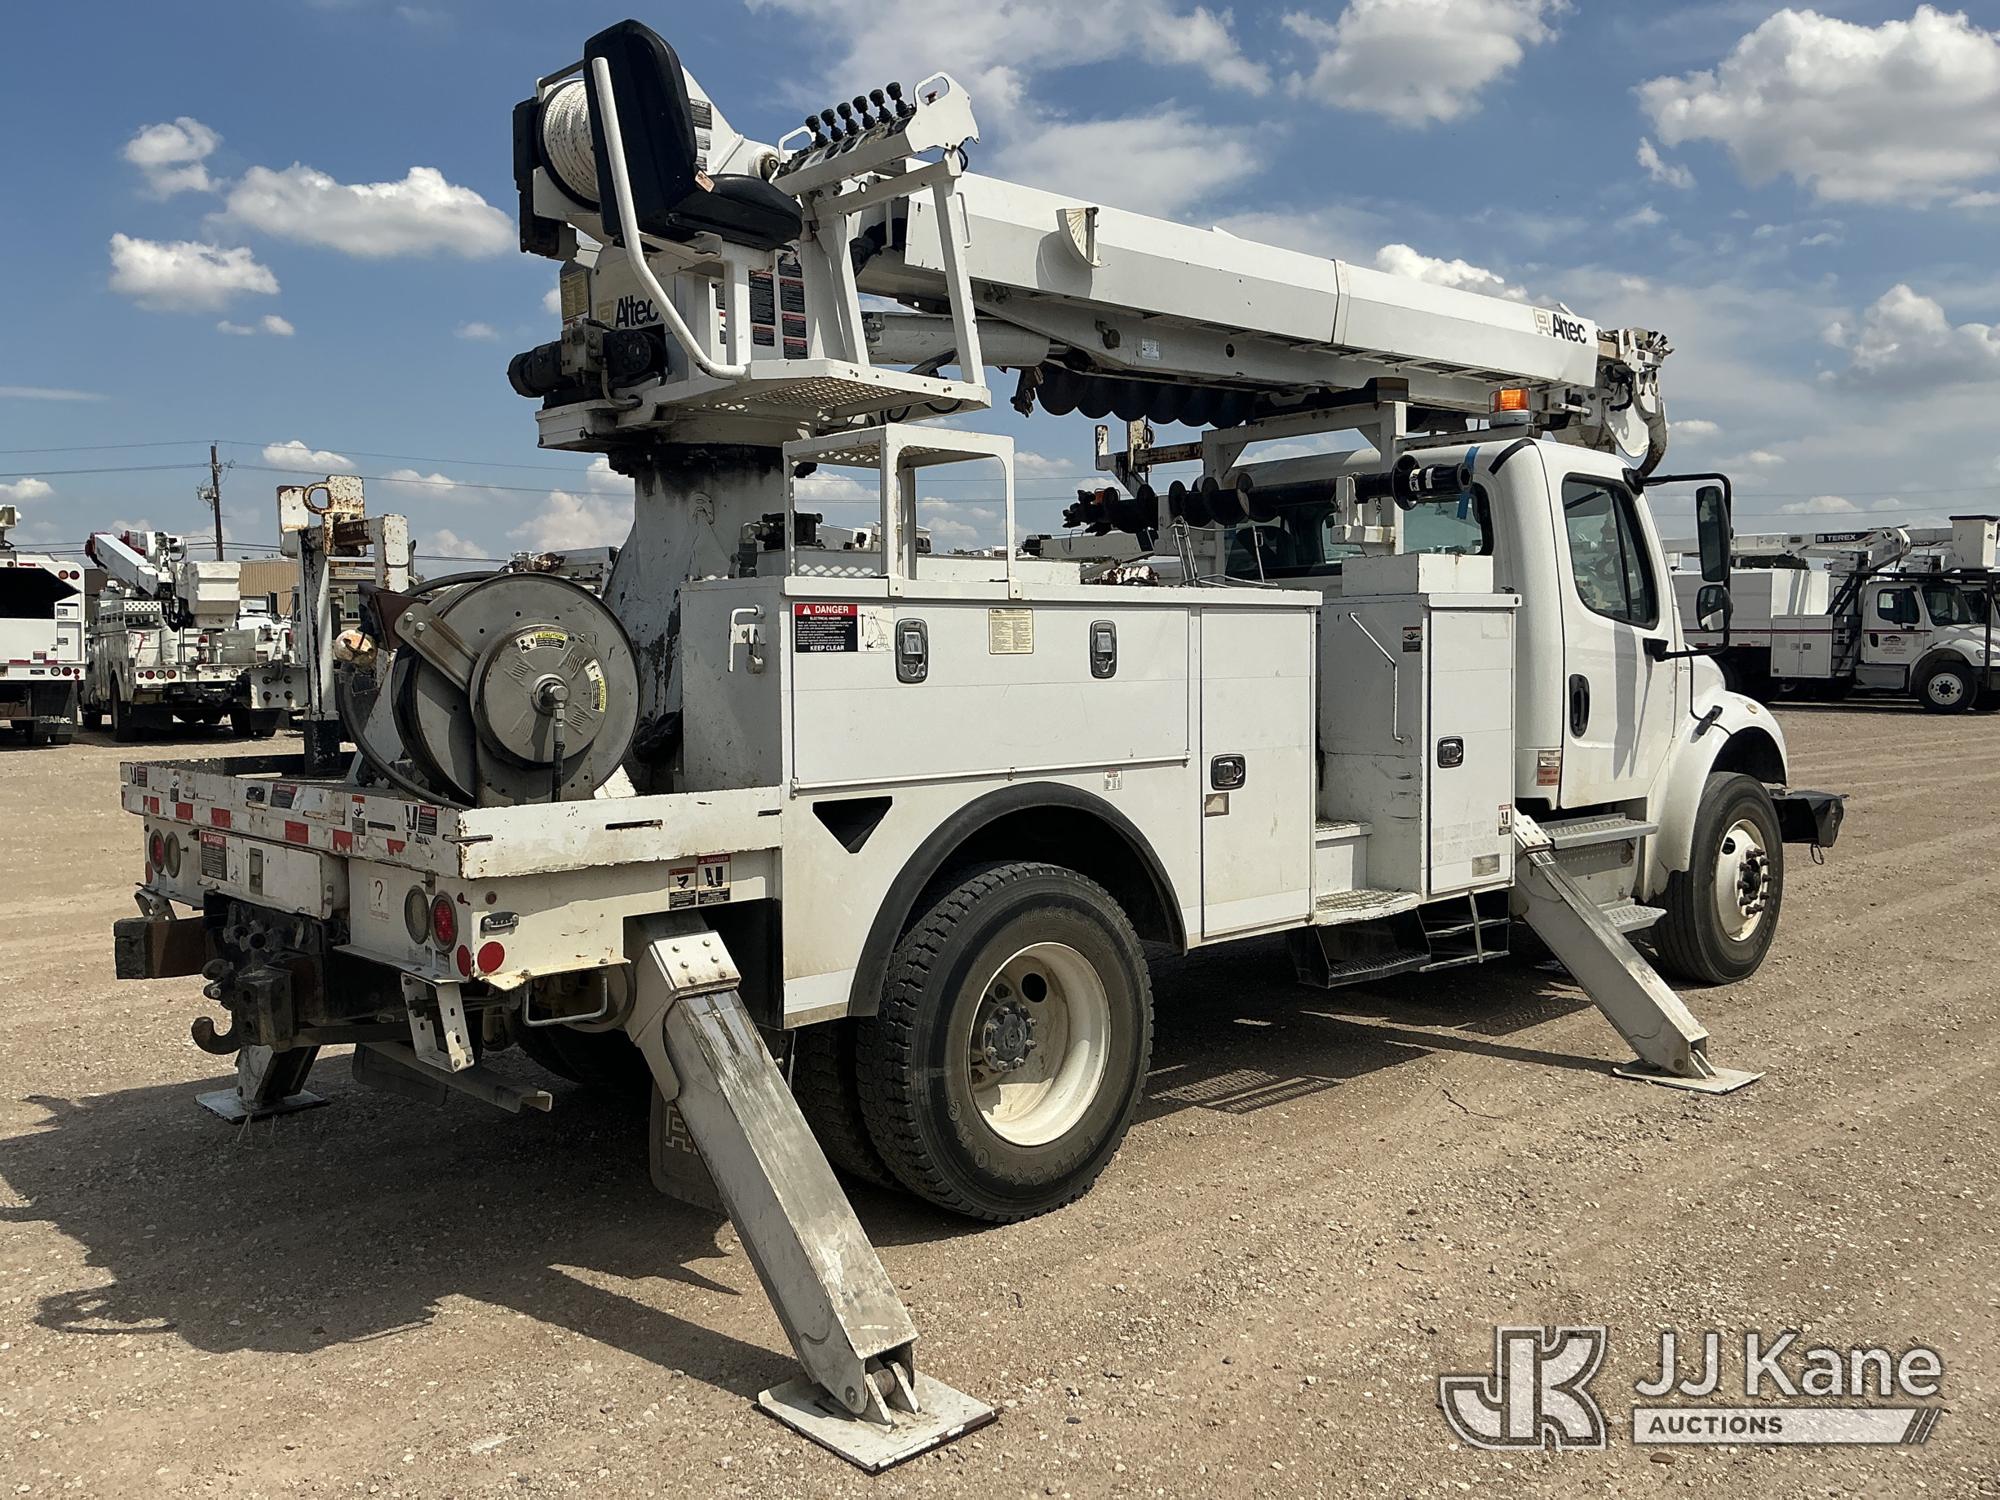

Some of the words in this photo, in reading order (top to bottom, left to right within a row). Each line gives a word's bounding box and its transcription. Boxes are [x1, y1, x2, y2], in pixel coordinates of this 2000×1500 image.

[616, 295, 659, 328] Altec
[1552, 313, 1587, 344] Altec
[1827, 534, 1856, 542] TEREX
[815, 605, 849, 614] DANGER
